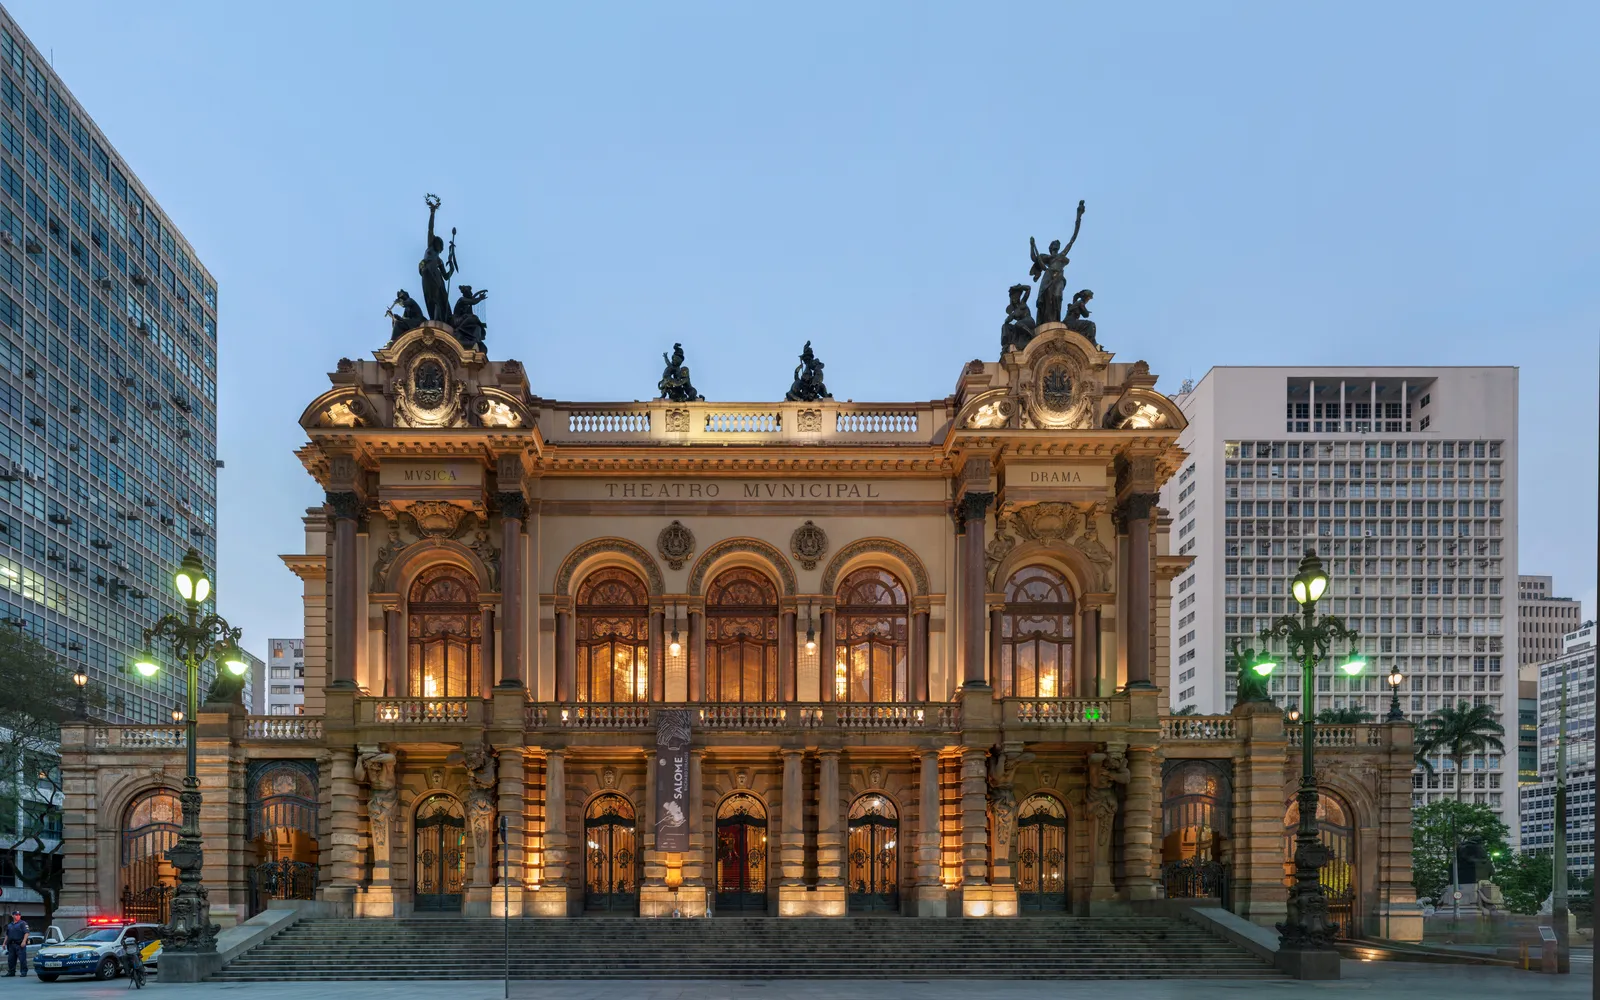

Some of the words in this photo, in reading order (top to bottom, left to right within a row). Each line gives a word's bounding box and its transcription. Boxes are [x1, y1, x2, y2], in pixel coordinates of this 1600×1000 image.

[404, 469, 457, 481] MVSICA
[1030, 471, 1081, 482] DRAMA
[605, 483, 720, 498] THEATRO
[743, 483, 880, 498] MVNICIPAL
[673, 757, 683, 800] SALOME
